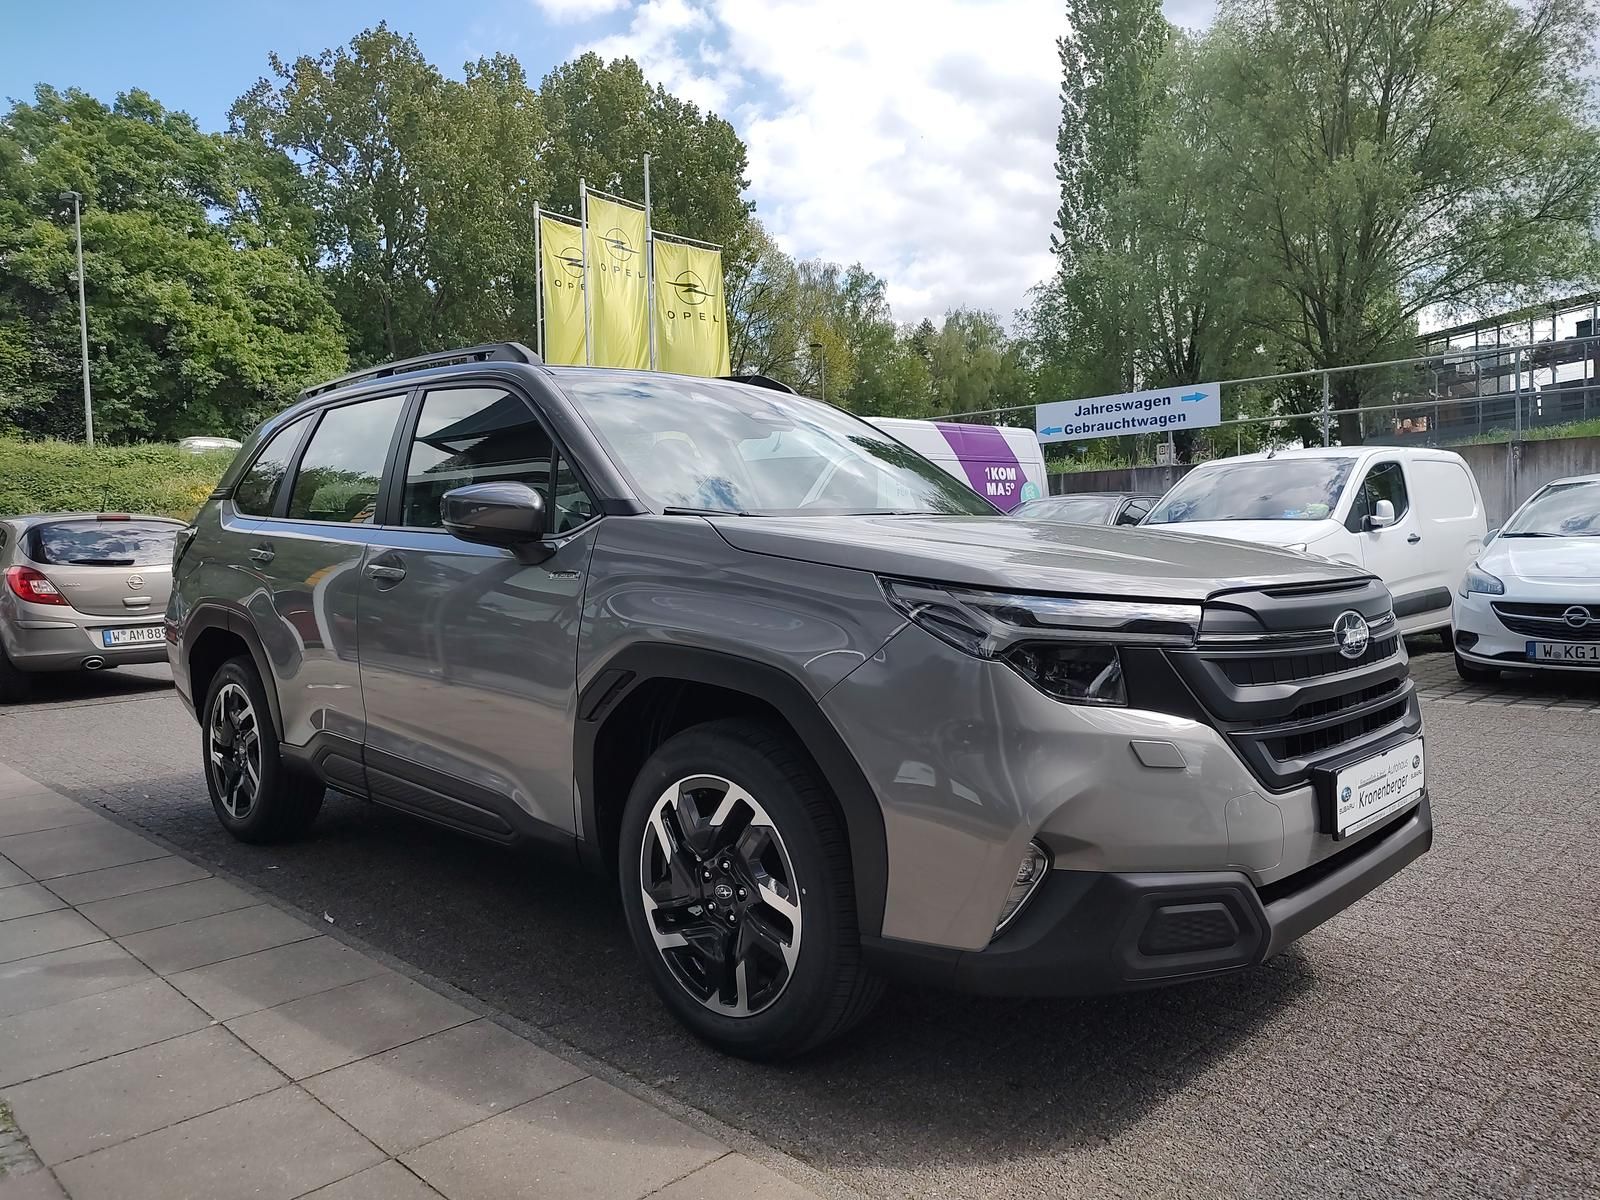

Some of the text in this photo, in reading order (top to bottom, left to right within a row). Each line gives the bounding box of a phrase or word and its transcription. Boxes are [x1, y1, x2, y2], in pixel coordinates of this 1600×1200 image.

[600, 263, 645, 279] OPEL
[554, 279, 585, 291] OPE
[667, 310, 720, 323] OPEL
[1074, 396, 1172, 417] Jahreswagen
[1064, 413, 1187, 436] Gebrauchtwagen
[984, 466, 1017, 481] 1KOM
[112, 631, 120, 642] W
[129, 630, 145, 641] AM
[1543, 644, 1600, 660] W KG 1
[1358, 774, 1409, 809] Kronenberger
